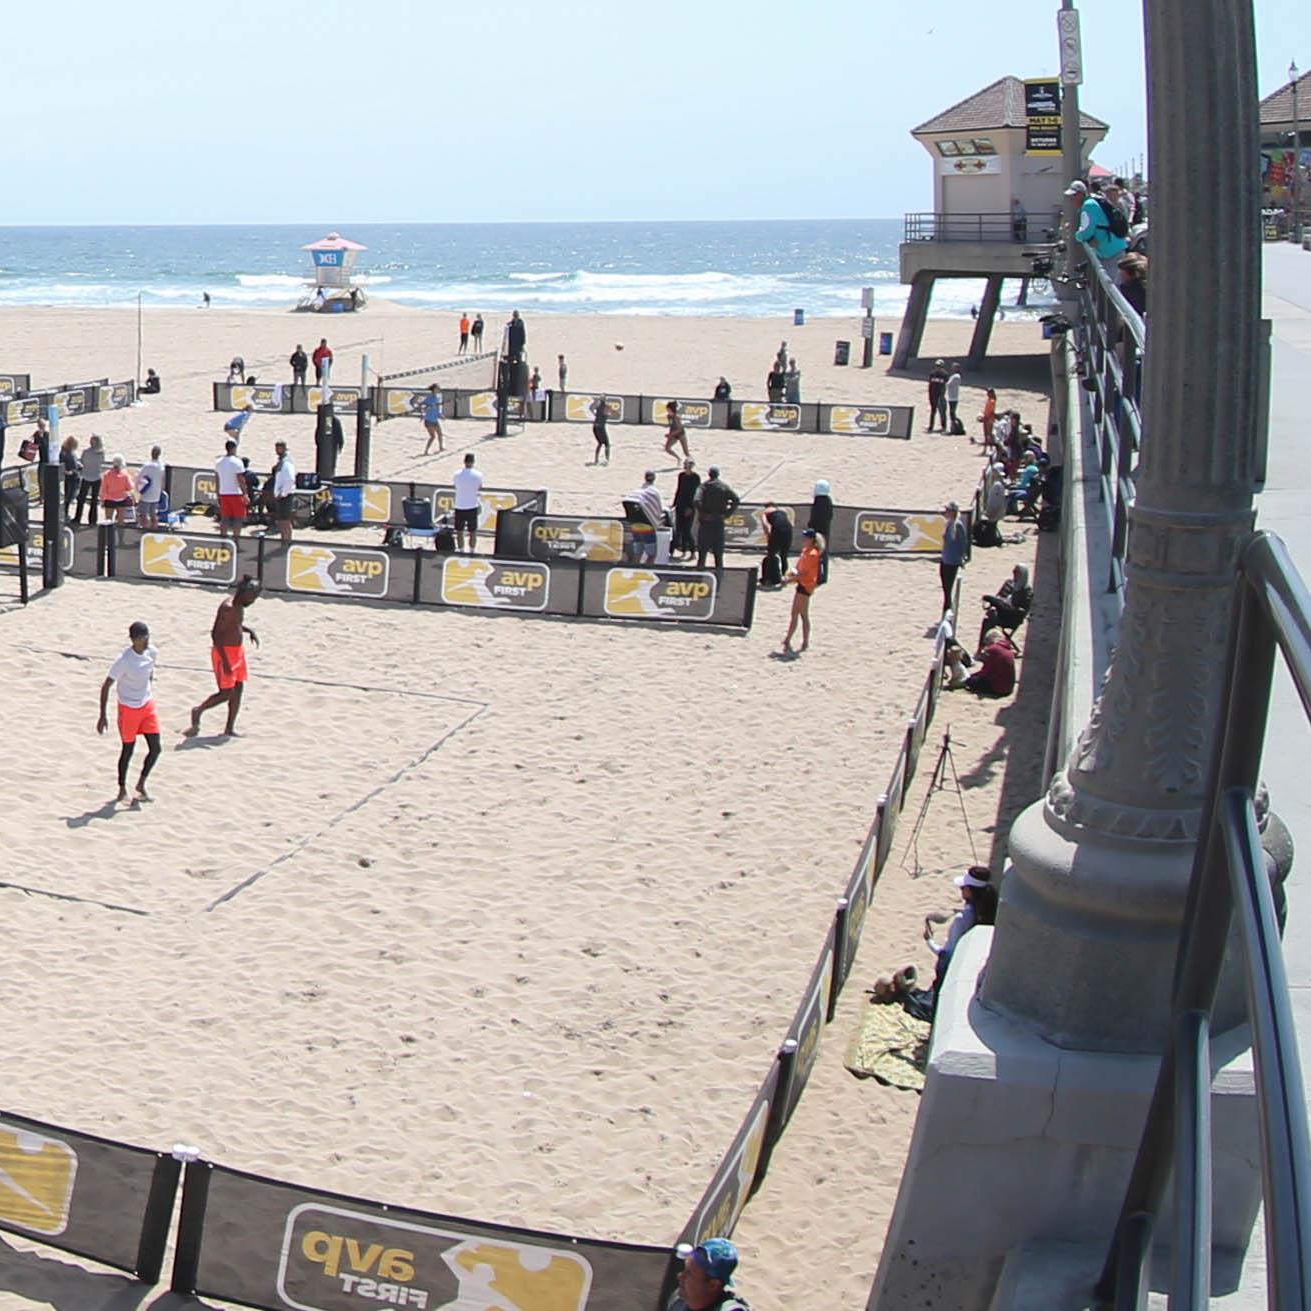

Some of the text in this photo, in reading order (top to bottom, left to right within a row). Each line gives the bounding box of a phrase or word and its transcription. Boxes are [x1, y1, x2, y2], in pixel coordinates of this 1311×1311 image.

[192, 545, 232, 565] avp
[186, 559, 216, 571] FIRST
[342, 557, 383, 579] avp
[335, 572, 367, 584] FIRST
[500, 570, 544, 591] avp
[493, 585, 526, 597] FIRST
[666, 580, 710, 601] avp
[658, 595, 692, 607] FIRST
